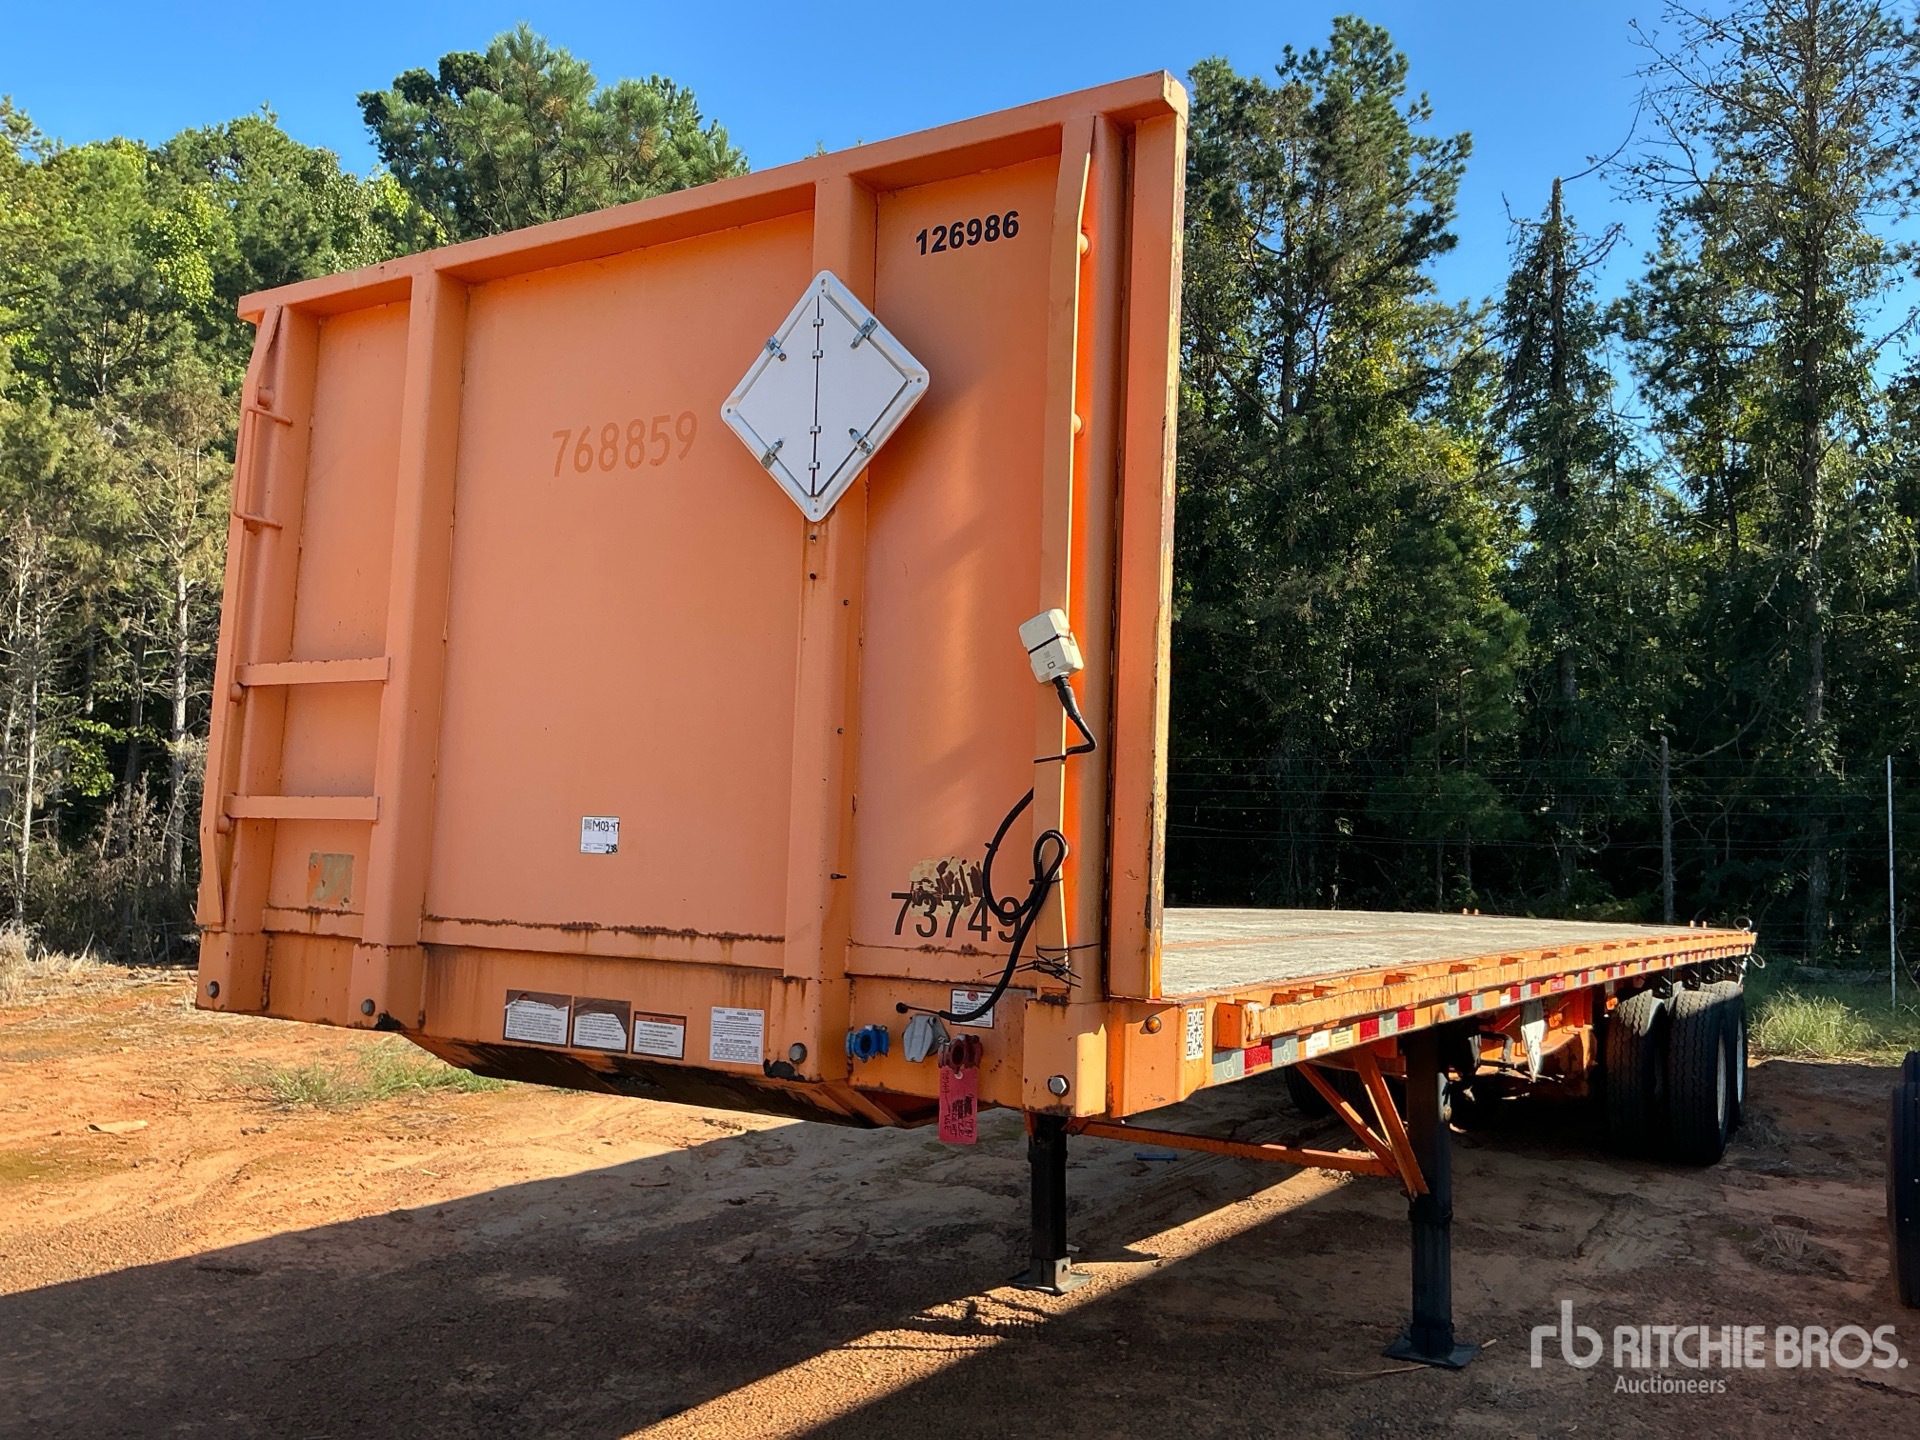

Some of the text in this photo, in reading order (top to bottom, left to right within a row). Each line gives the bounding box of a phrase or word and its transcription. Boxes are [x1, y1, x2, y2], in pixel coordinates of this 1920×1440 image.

[916, 210, 1019, 255] 126986
[552, 410, 697, 477] 768859
[891, 892, 1021, 942] 73749
